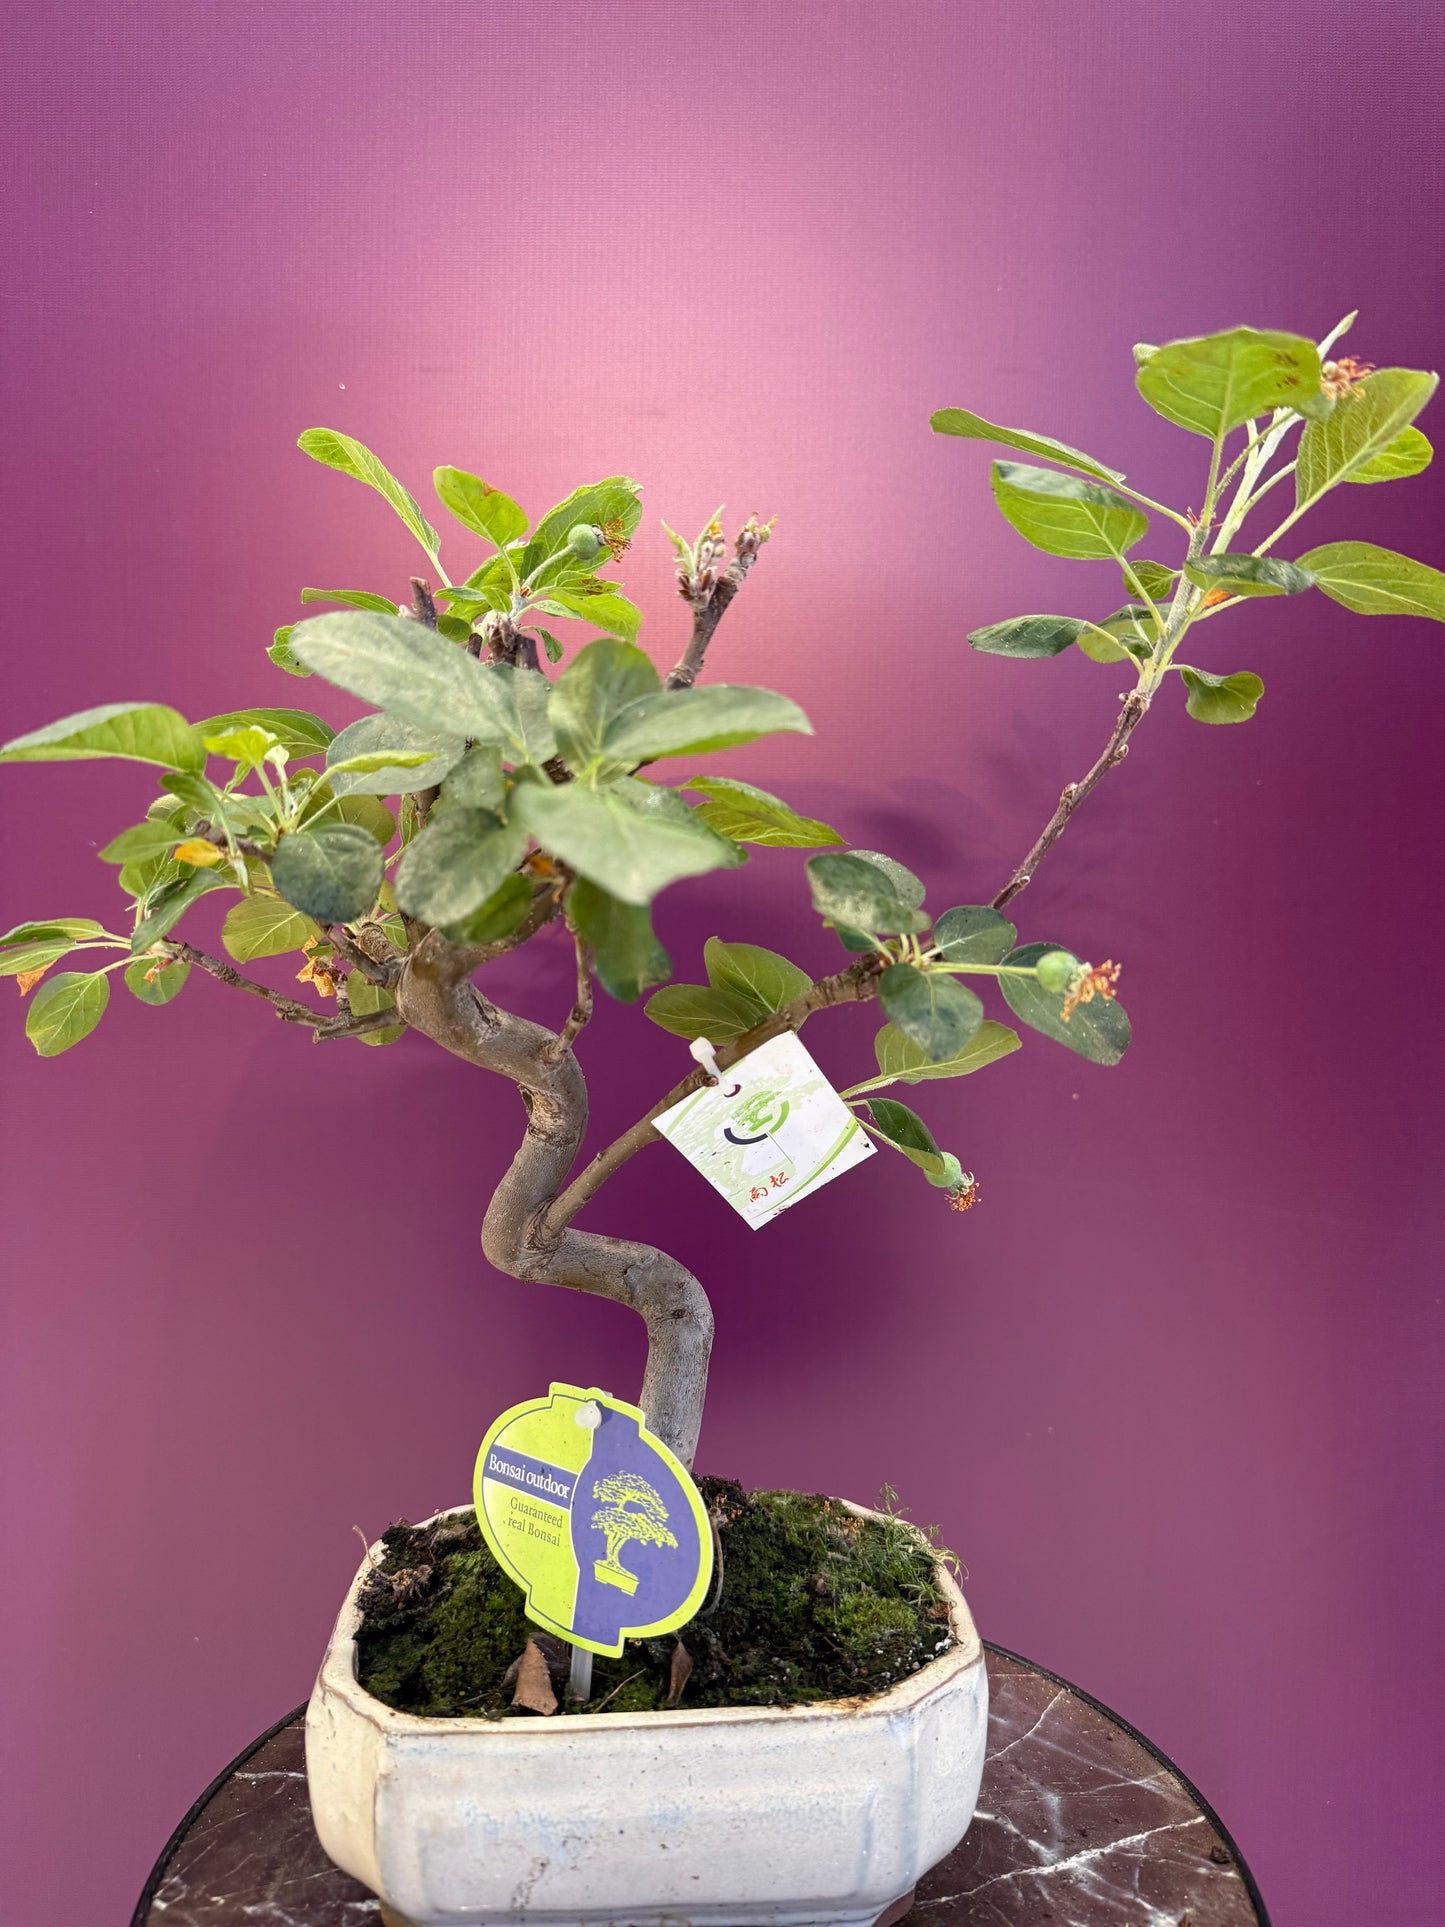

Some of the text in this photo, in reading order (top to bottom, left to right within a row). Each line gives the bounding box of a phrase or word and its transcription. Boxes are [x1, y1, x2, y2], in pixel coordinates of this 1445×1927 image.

[488, 1453, 571, 1499] Bonsai outdoor
[510, 1496, 563, 1529] Guaranteed
[507, 1517, 561, 1547] real Bonsai
